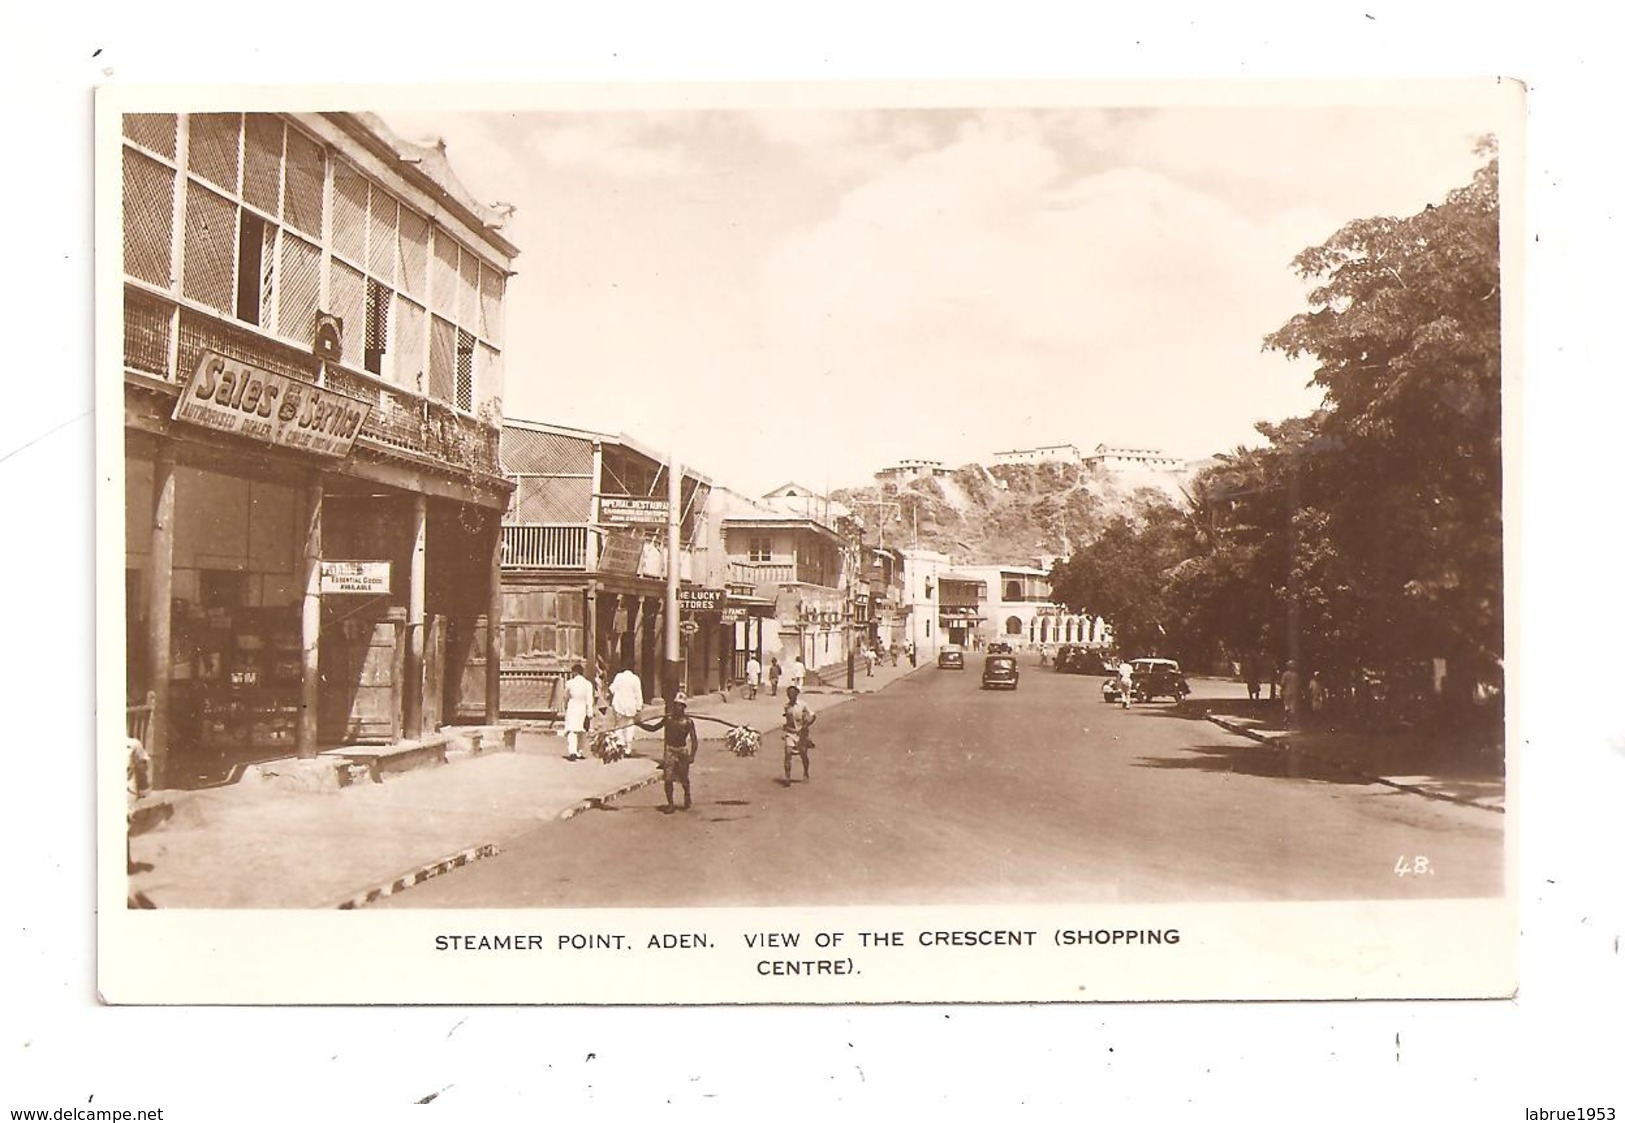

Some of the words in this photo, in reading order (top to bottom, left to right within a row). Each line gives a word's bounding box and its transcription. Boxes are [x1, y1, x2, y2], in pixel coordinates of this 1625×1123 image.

[196, 358, 279, 419] Sales
[297, 393, 361, 439] Service
[691, 591, 721, 601] LUCKY
